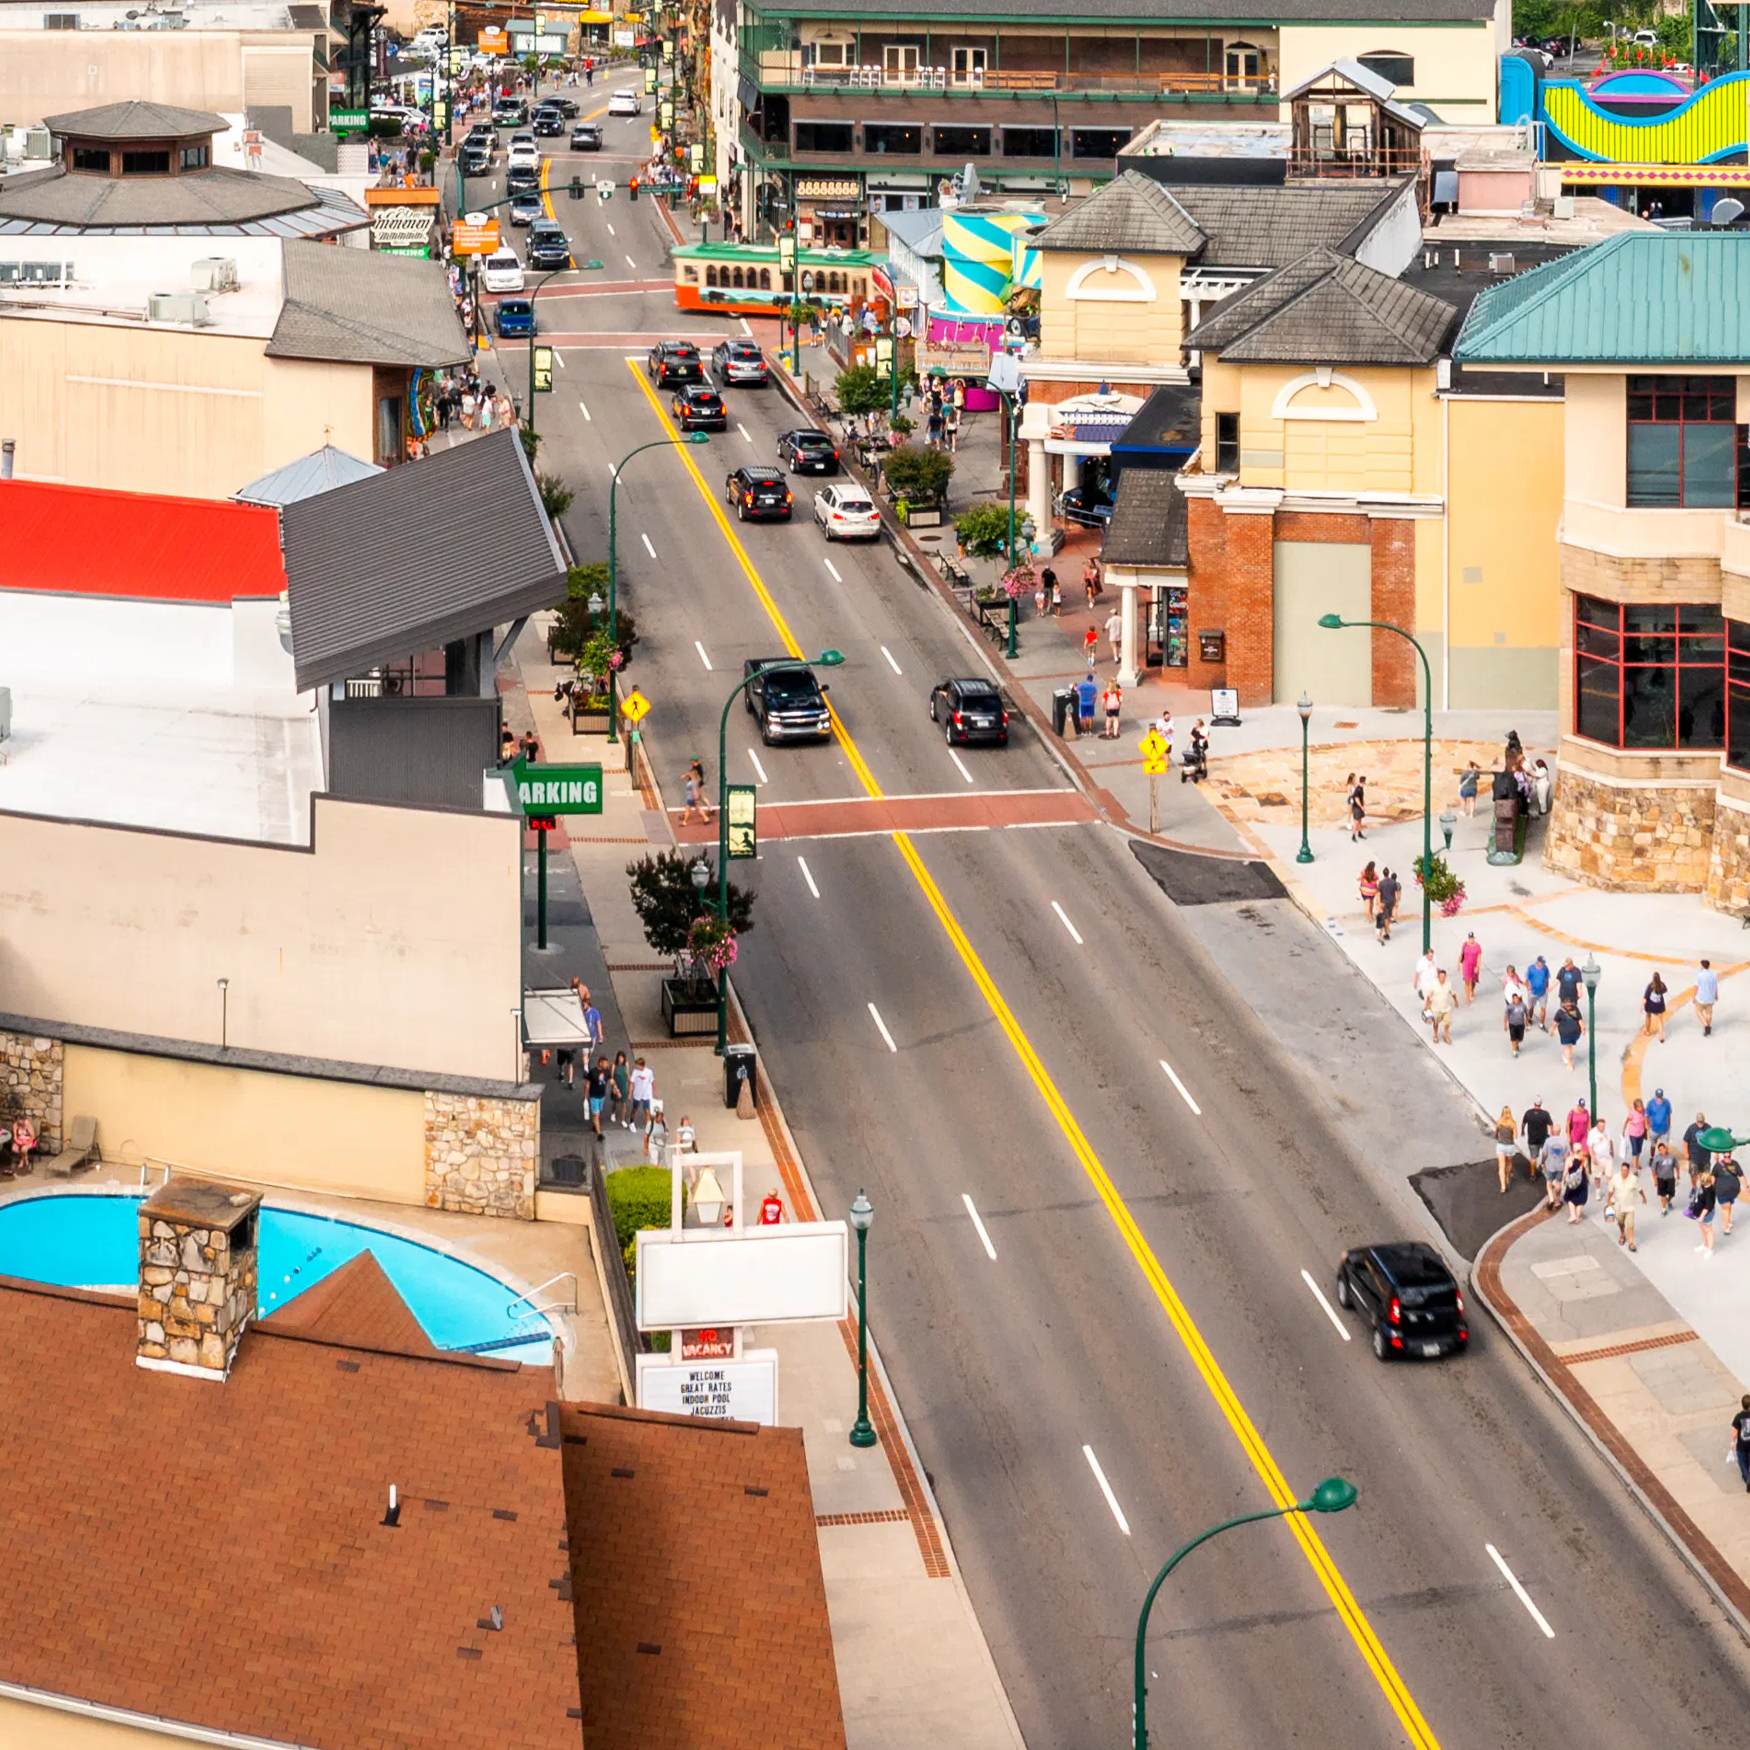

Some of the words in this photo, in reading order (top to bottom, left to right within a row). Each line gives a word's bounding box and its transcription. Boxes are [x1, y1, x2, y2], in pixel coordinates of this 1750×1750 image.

[518, 781, 598, 804] ARKING
[699, 1329, 718, 1342] NO
[682, 1342, 733, 1356] VACANCY
[689, 1370, 725, 1381] WELCOME
[681, 1383, 704, 1393] GREAT
[708, 1382, 732, 1392] RATES
[682, 1394, 709, 1405] INDOOR
[712, 1393, 731, 1403] POOL
[692, 1405, 727, 1416] JACUZZIS
